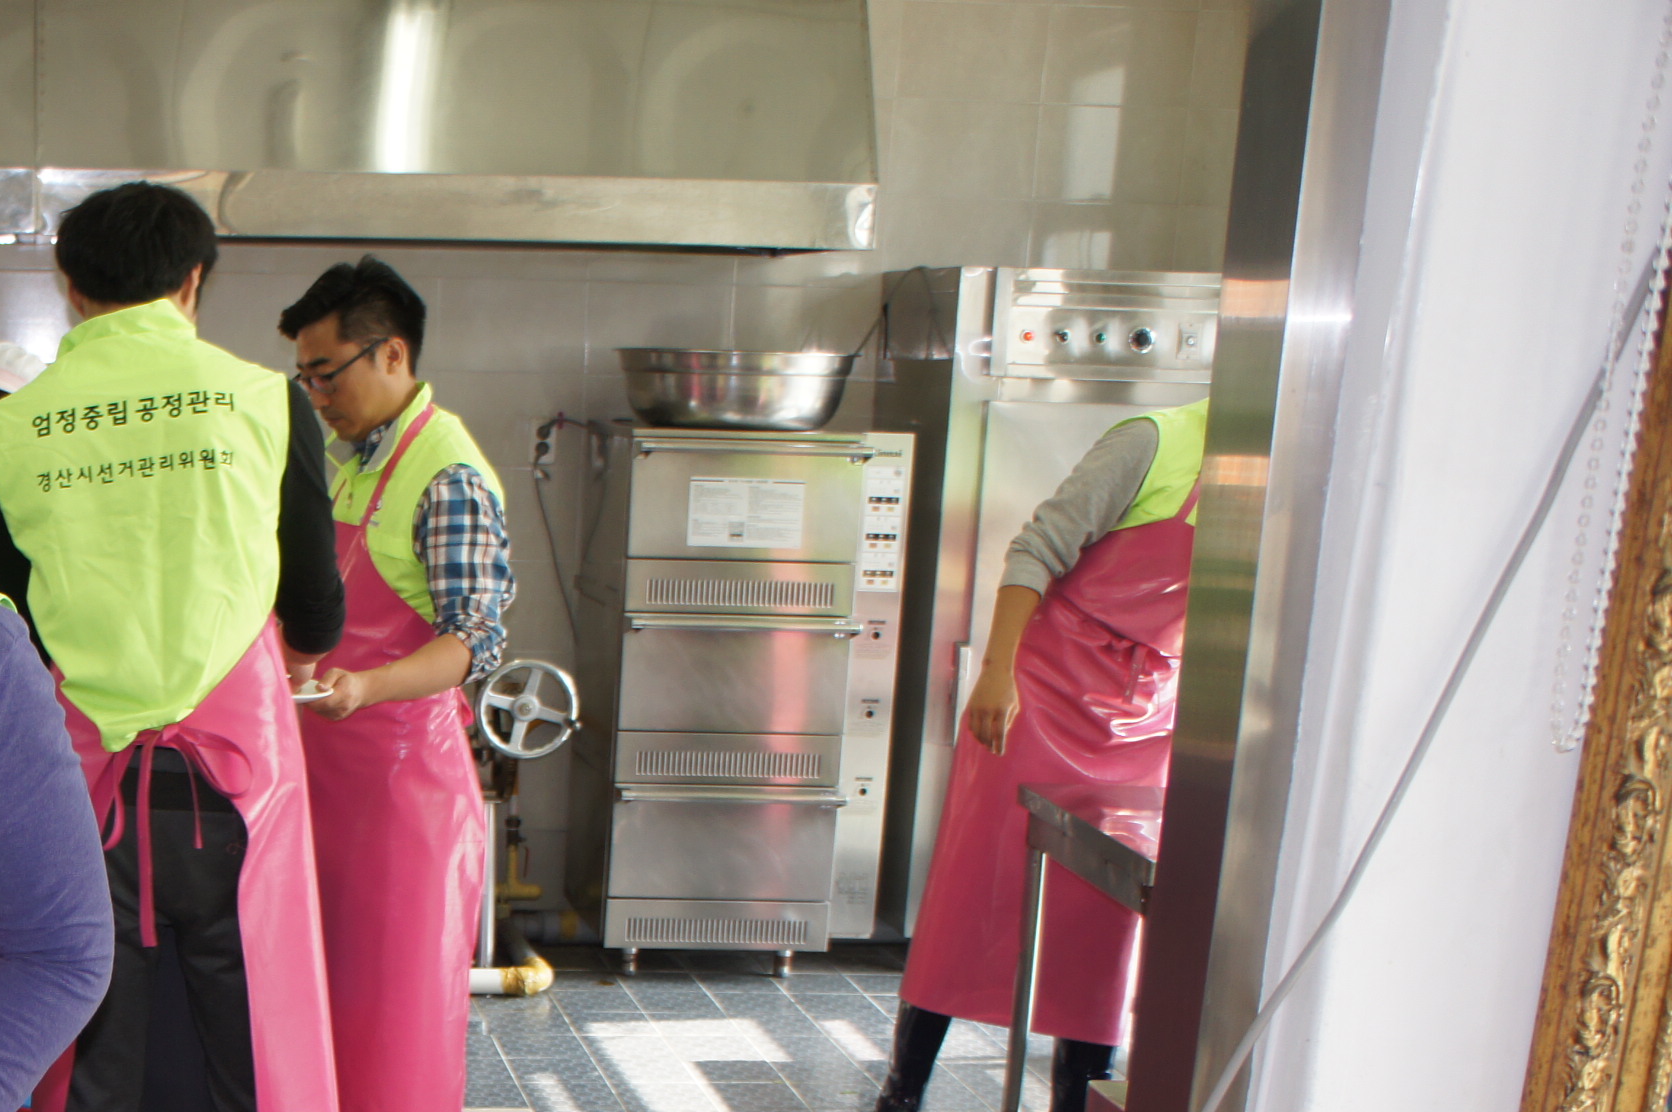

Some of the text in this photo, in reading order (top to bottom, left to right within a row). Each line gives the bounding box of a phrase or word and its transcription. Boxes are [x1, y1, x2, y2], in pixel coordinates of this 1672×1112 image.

[32, 390, 235, 438] 엄정중립 공정관리
[36, 448, 234, 493] 경산시선거관리위원회
